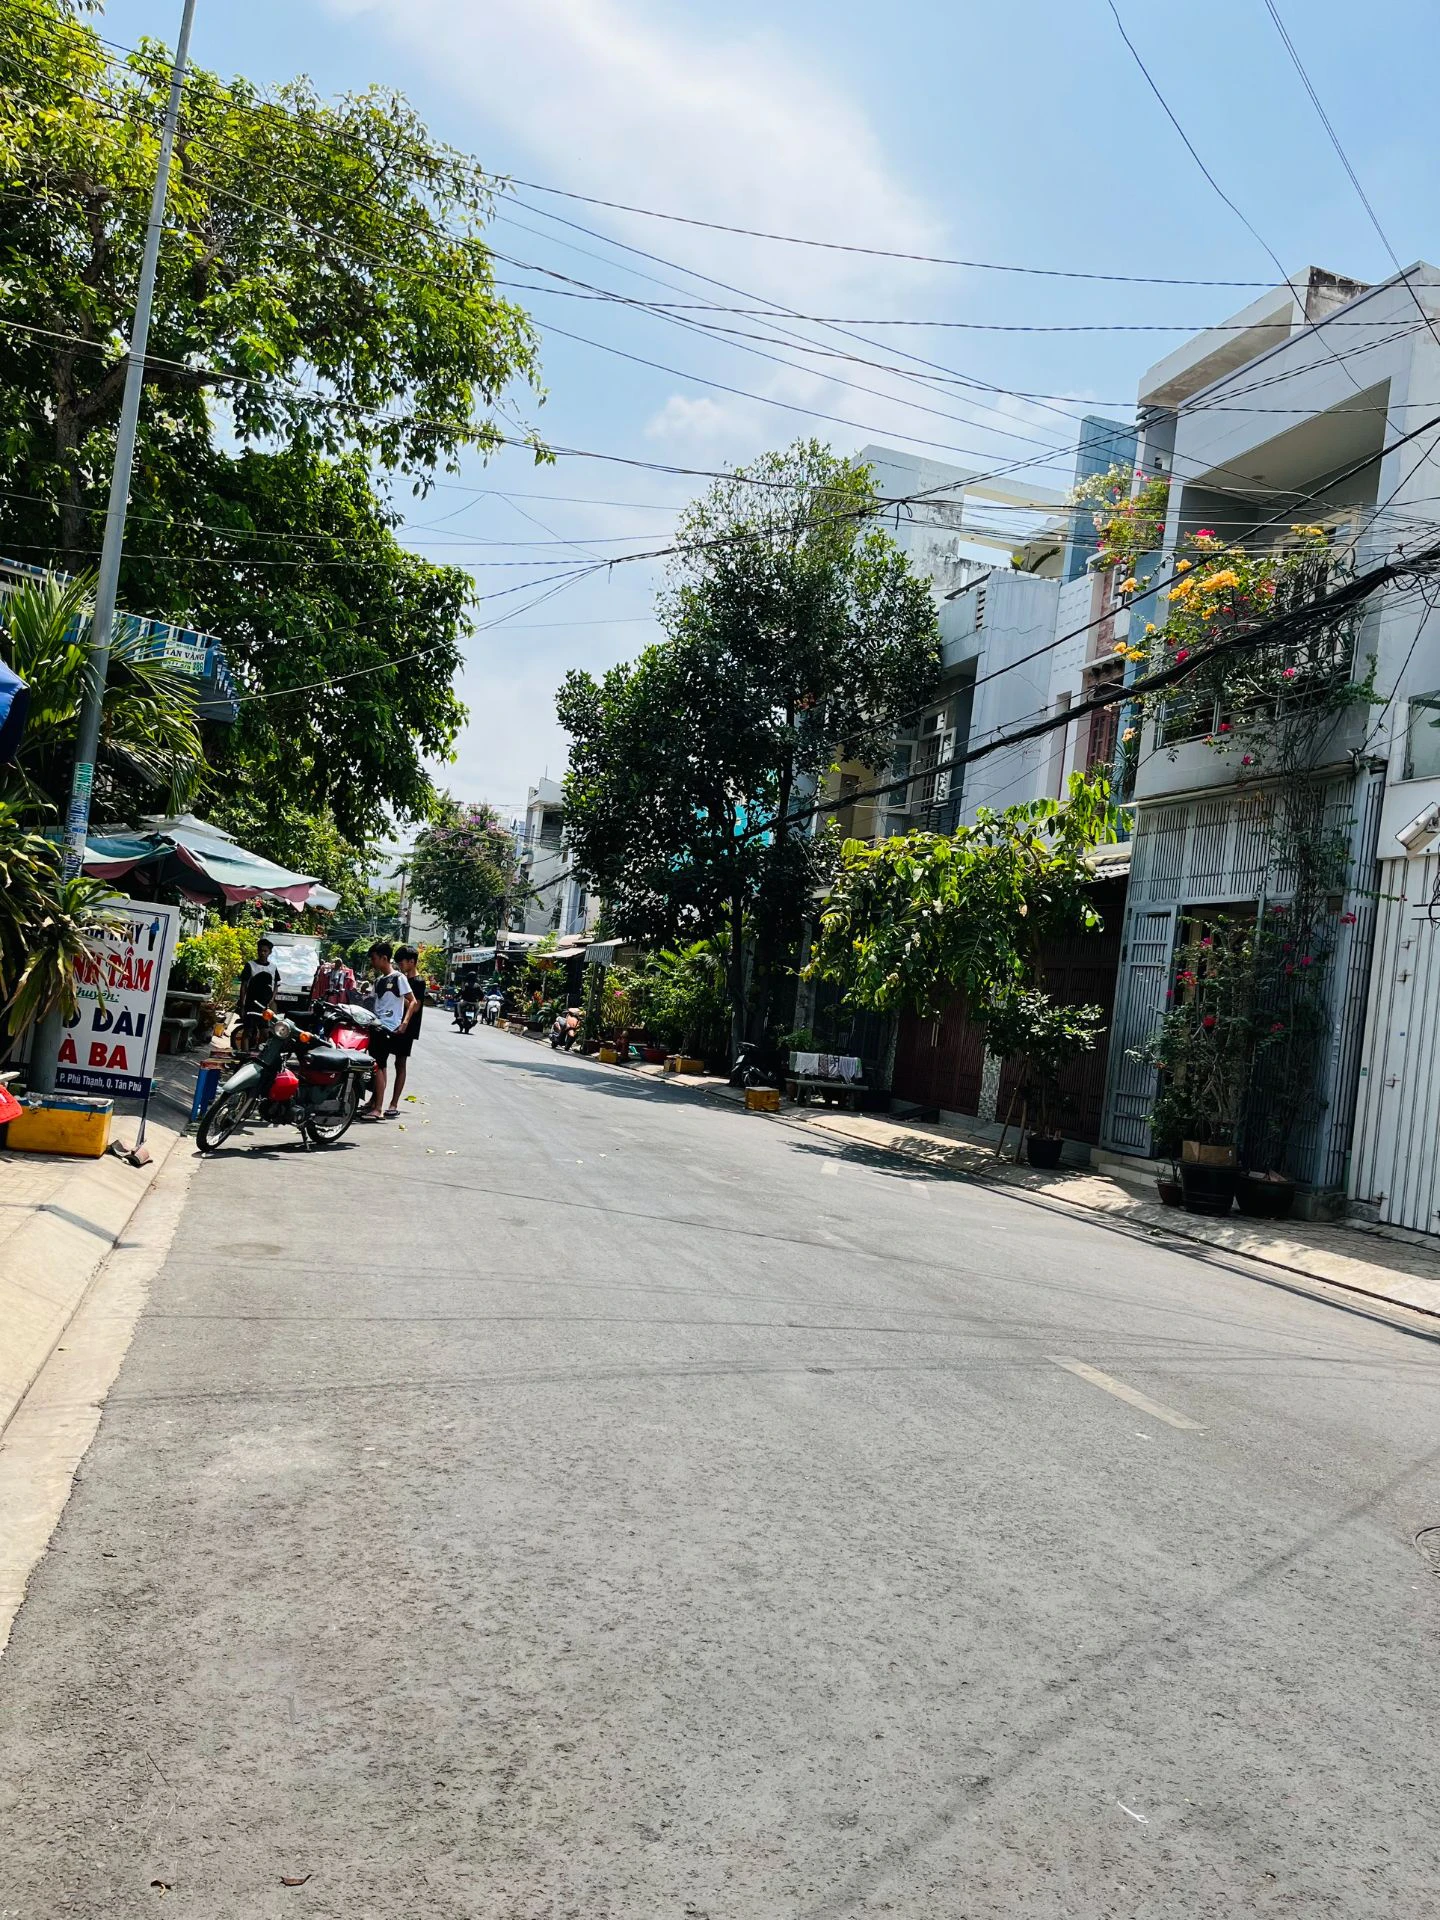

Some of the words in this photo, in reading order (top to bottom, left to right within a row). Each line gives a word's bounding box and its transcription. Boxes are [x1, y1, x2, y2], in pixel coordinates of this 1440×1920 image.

[107, 946, 154, 992] TÂM
[76, 985, 120, 1002] huyên:
[62, 1006, 82, 1029] O
[91, 1005, 147, 1038] DÀI
[57, 1032, 78, 1065] À
[88, 1041, 128, 1071] BA
[59, 1072, 66, 1083] P.
[82, 1075, 105, 1088] Thạnh,
[106, 1078, 113, 1089] Q.
